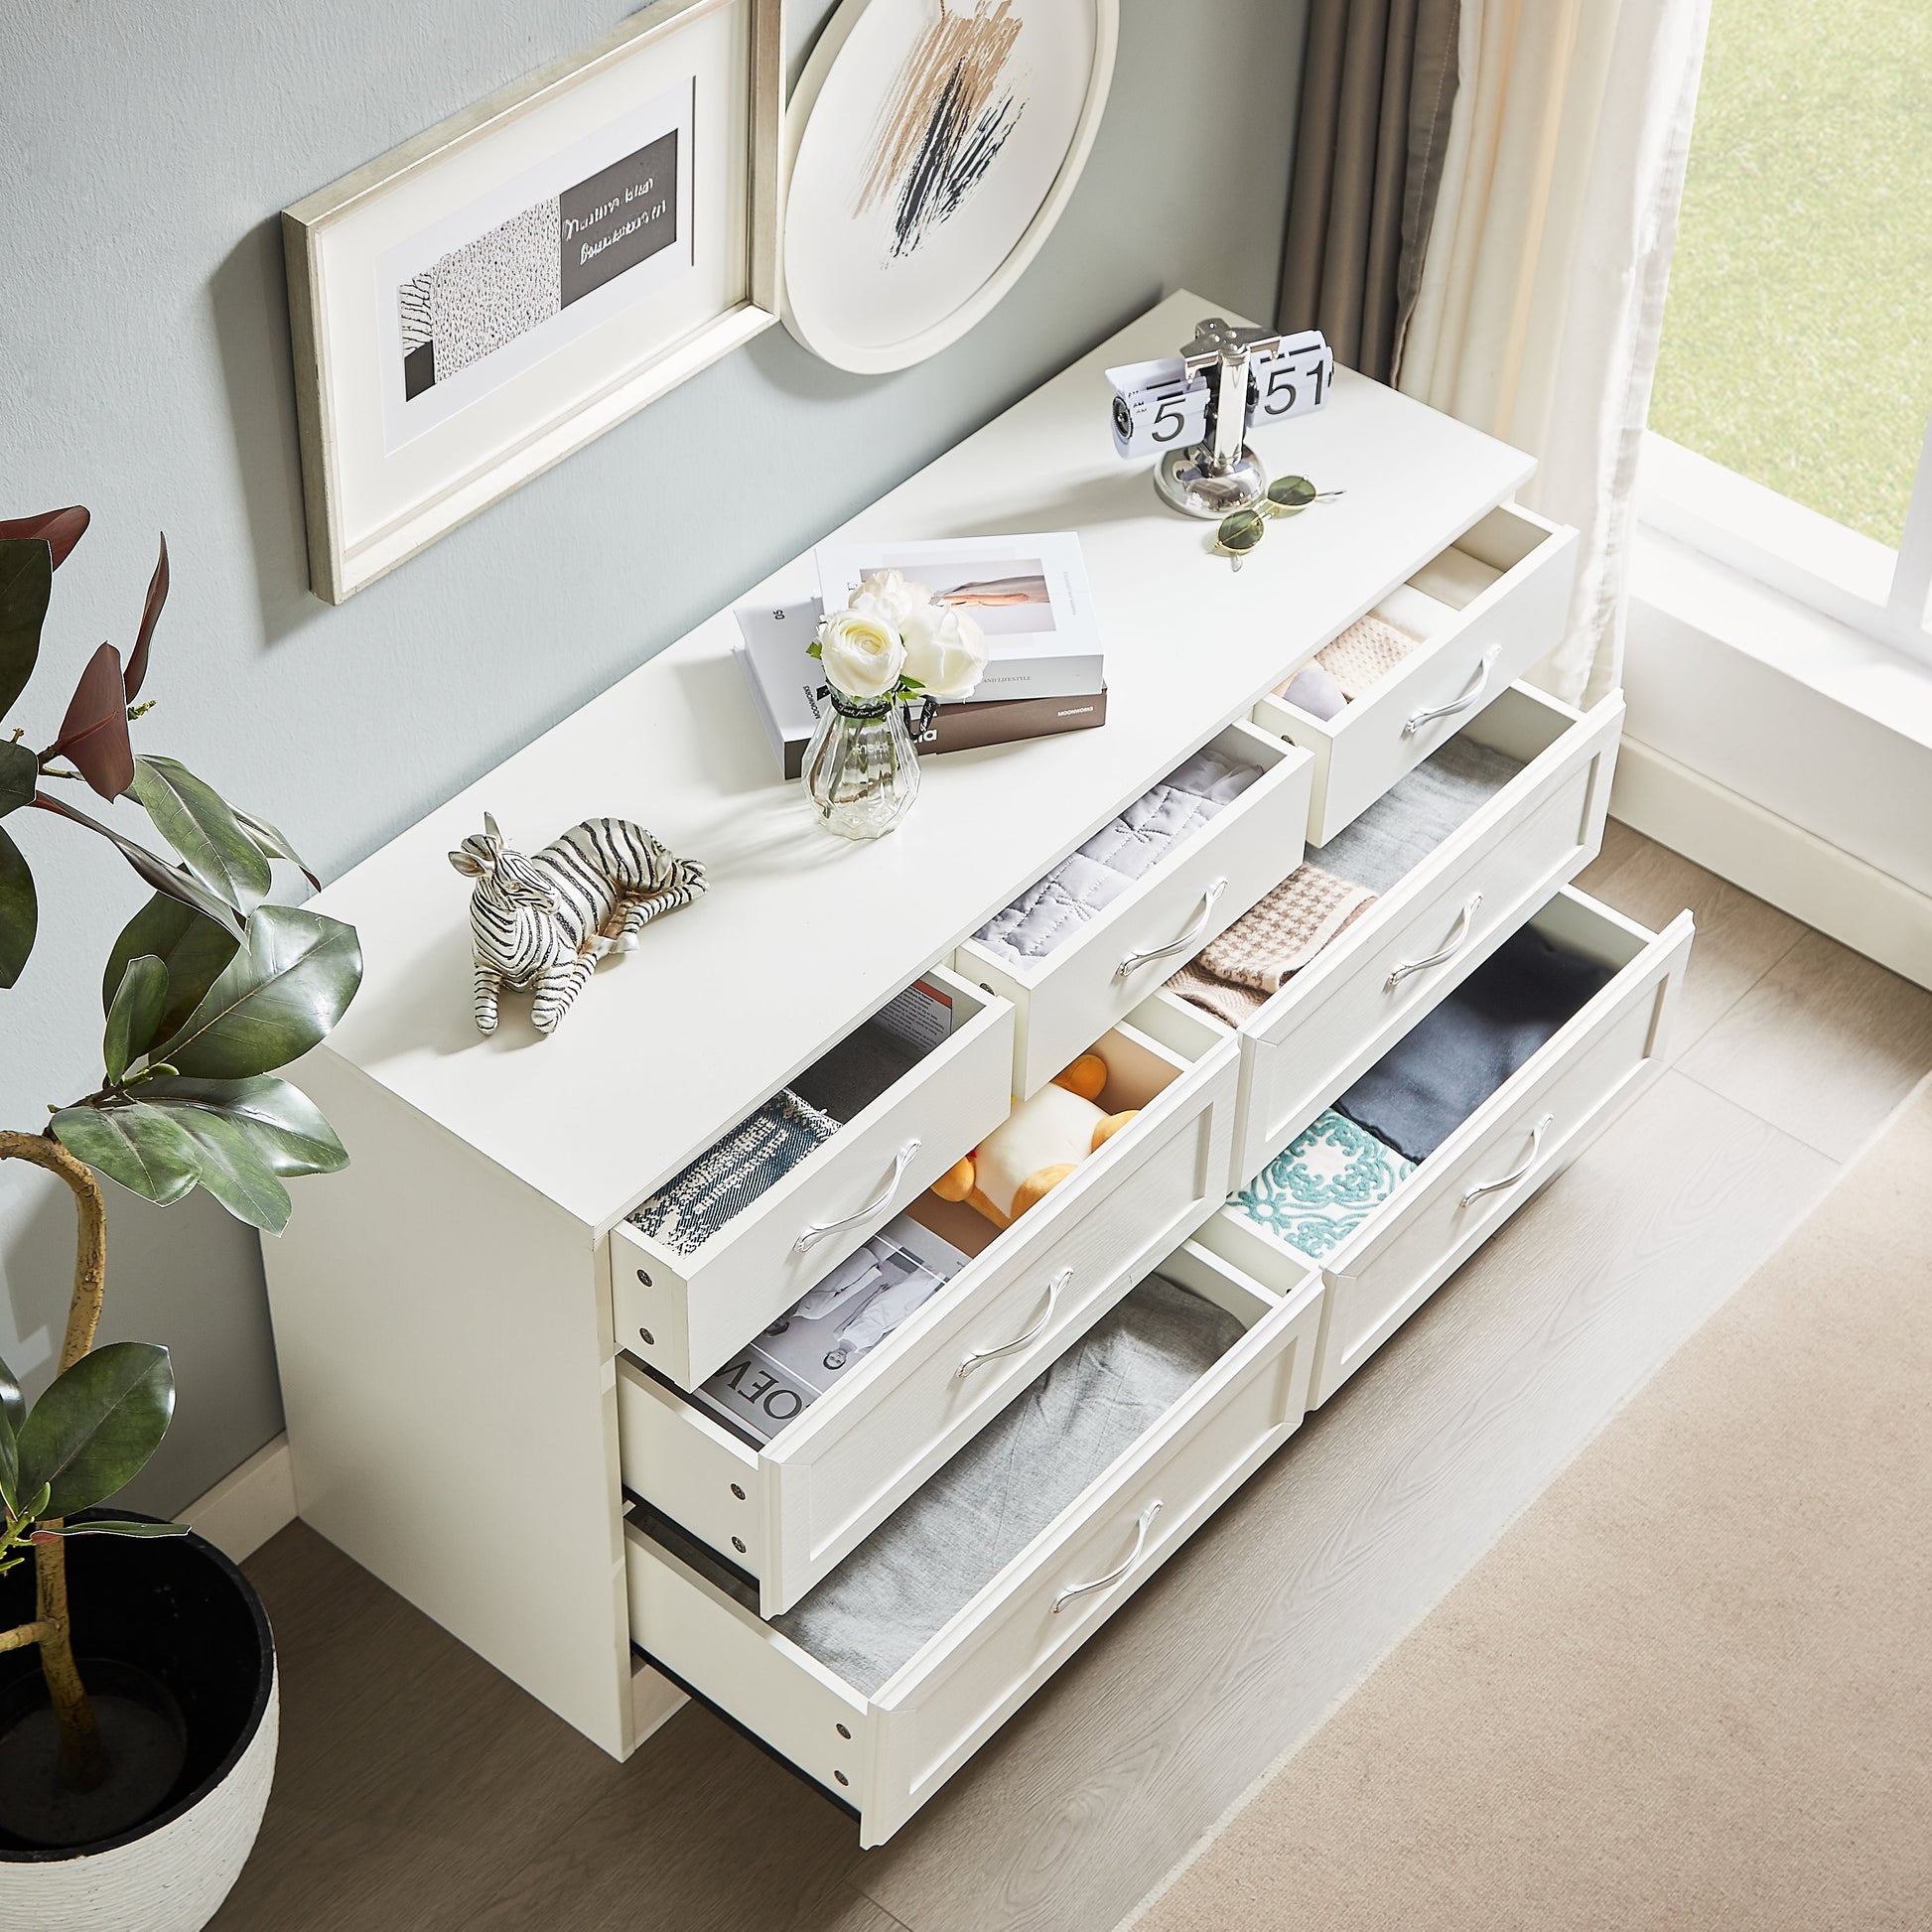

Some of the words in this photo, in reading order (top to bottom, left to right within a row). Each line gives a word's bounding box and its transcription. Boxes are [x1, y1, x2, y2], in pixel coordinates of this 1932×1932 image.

[1151, 398, 1186, 443] 5
[1264, 360, 1324, 416] 51
[772, 610, 785, 621] 05
[1057, 706, 1094, 717] MOONWORKS
